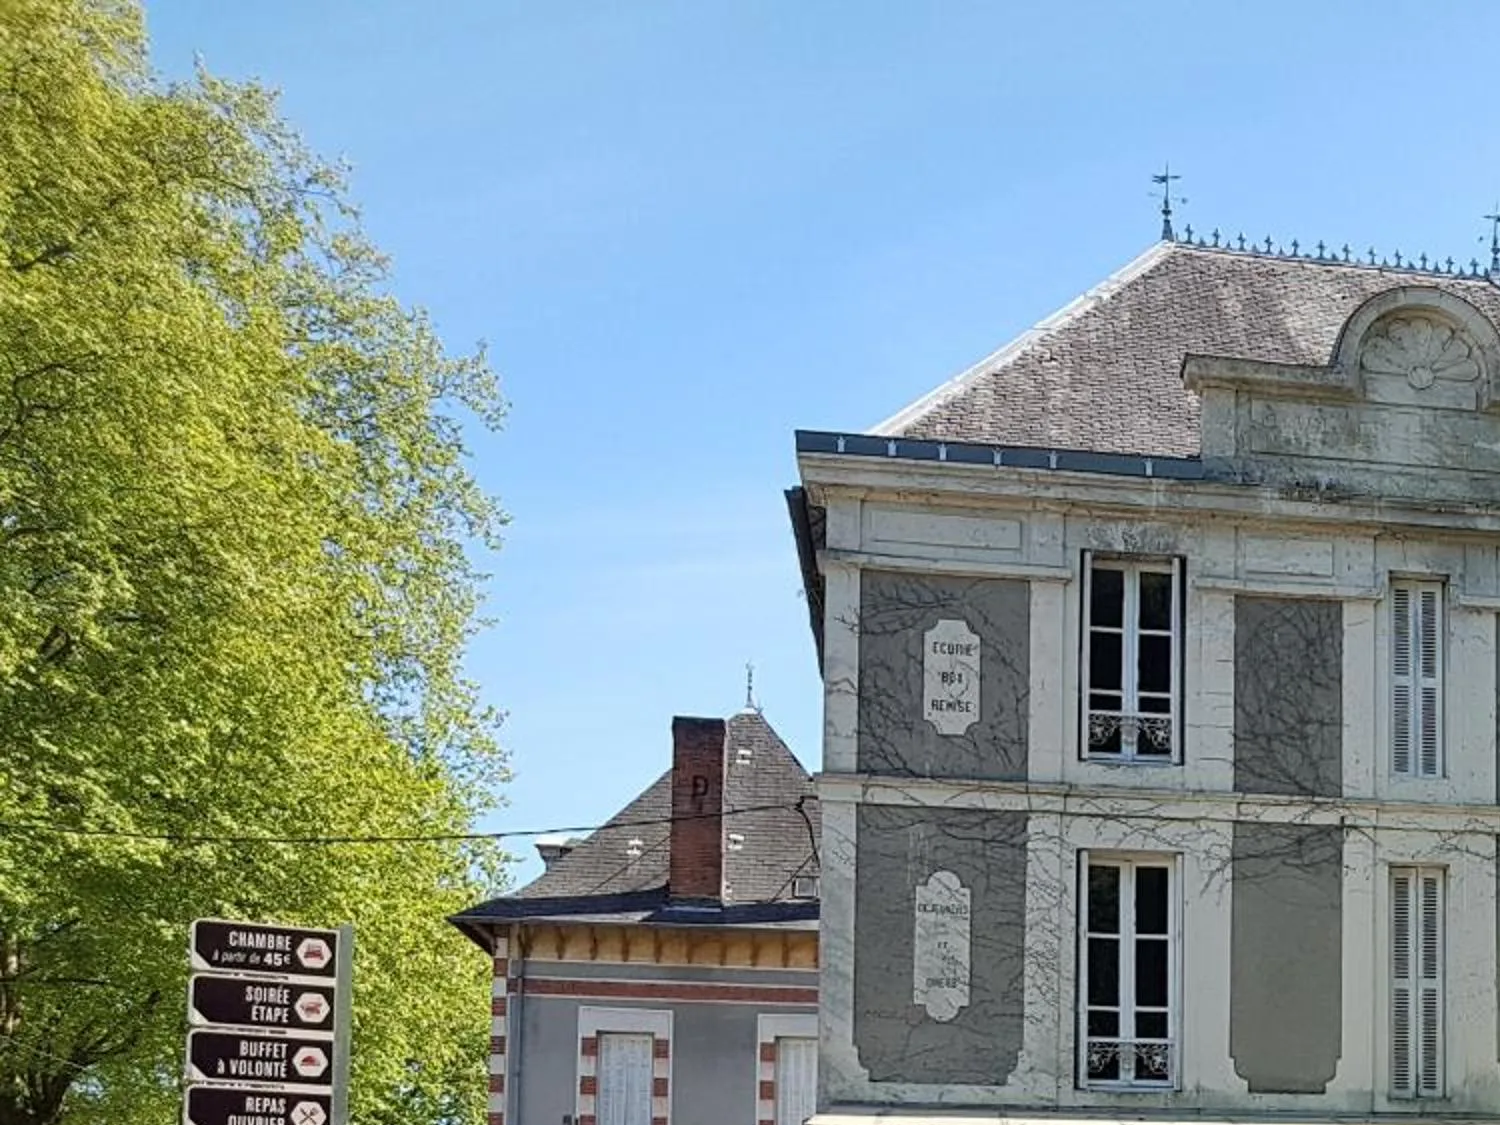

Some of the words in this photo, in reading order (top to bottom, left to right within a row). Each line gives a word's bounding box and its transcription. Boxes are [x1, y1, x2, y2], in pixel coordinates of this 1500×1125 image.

[228, 931, 292, 951] CHAMBRE
[263, 952, 292, 967] 45€
[245, 985, 290, 1005] SOIRÉE
[240, 1040, 288, 1059] BUFFET
[229, 1058, 287, 1078] VOLONTÉ
[245, 1096, 287, 1114] REPAS
